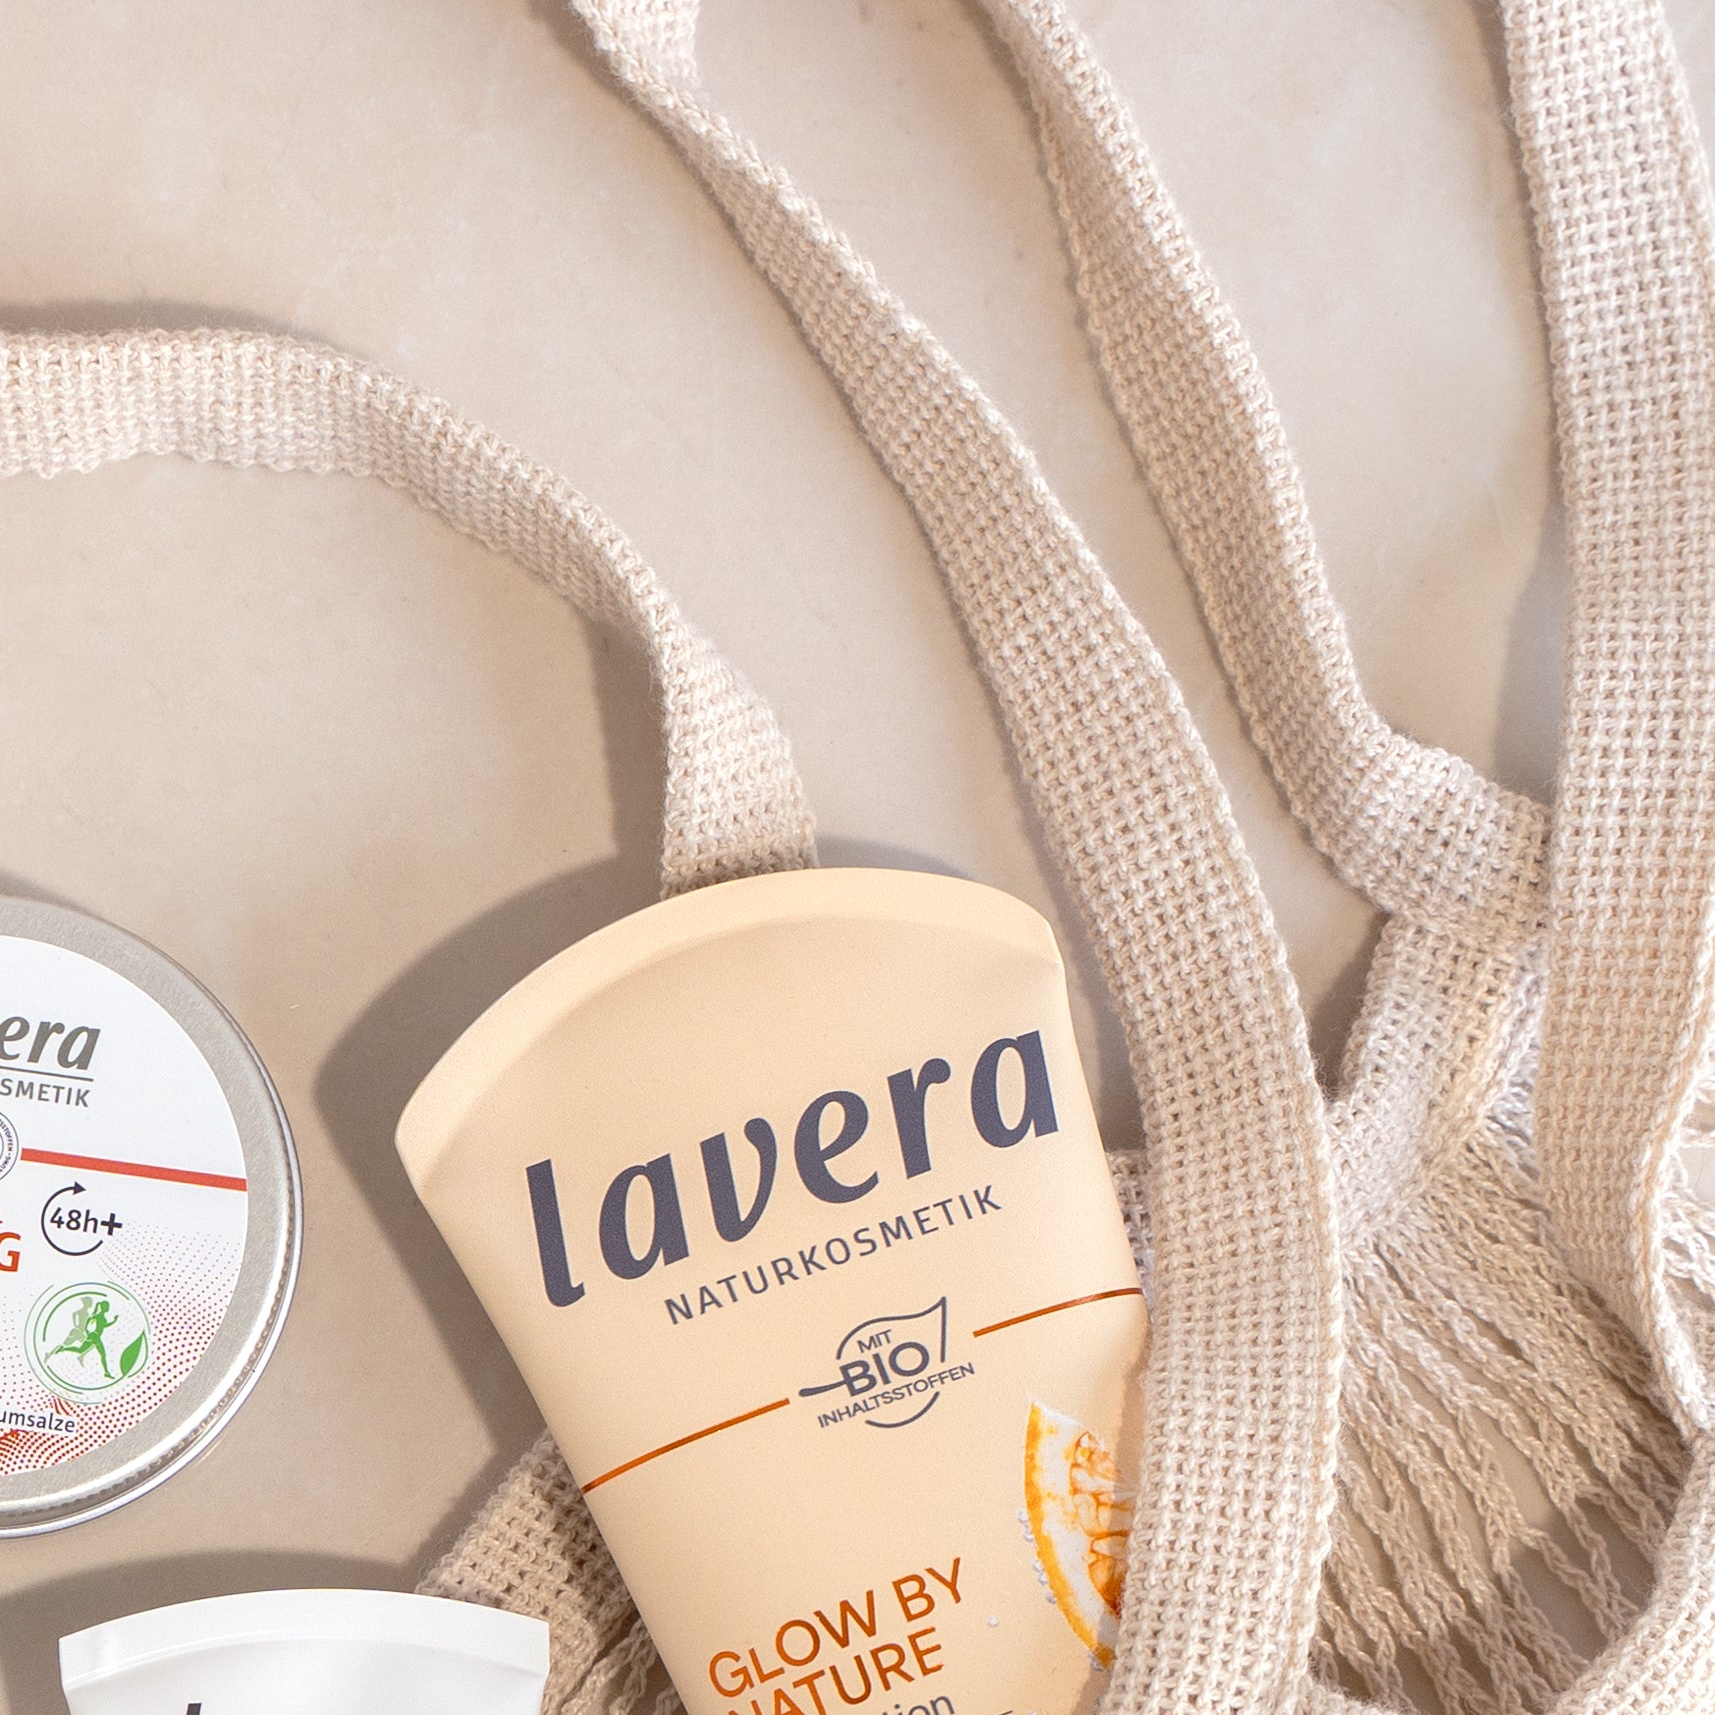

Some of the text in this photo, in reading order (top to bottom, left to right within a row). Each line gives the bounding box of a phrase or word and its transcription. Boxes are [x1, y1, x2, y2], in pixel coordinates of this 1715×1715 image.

[525, 1030, 1059, 1308] lavera
[49, 1206, 123, 1236] 48h+
[664, 1185, 1002, 1324] NATURKOSMETIK
[839, 1342, 930, 1397] BIO
[857, 1329, 892, 1353] MIT
[817, 1362, 975, 1428] INHALTSSTOFFEN
[709, 1557, 962, 1698] GLOW BY
